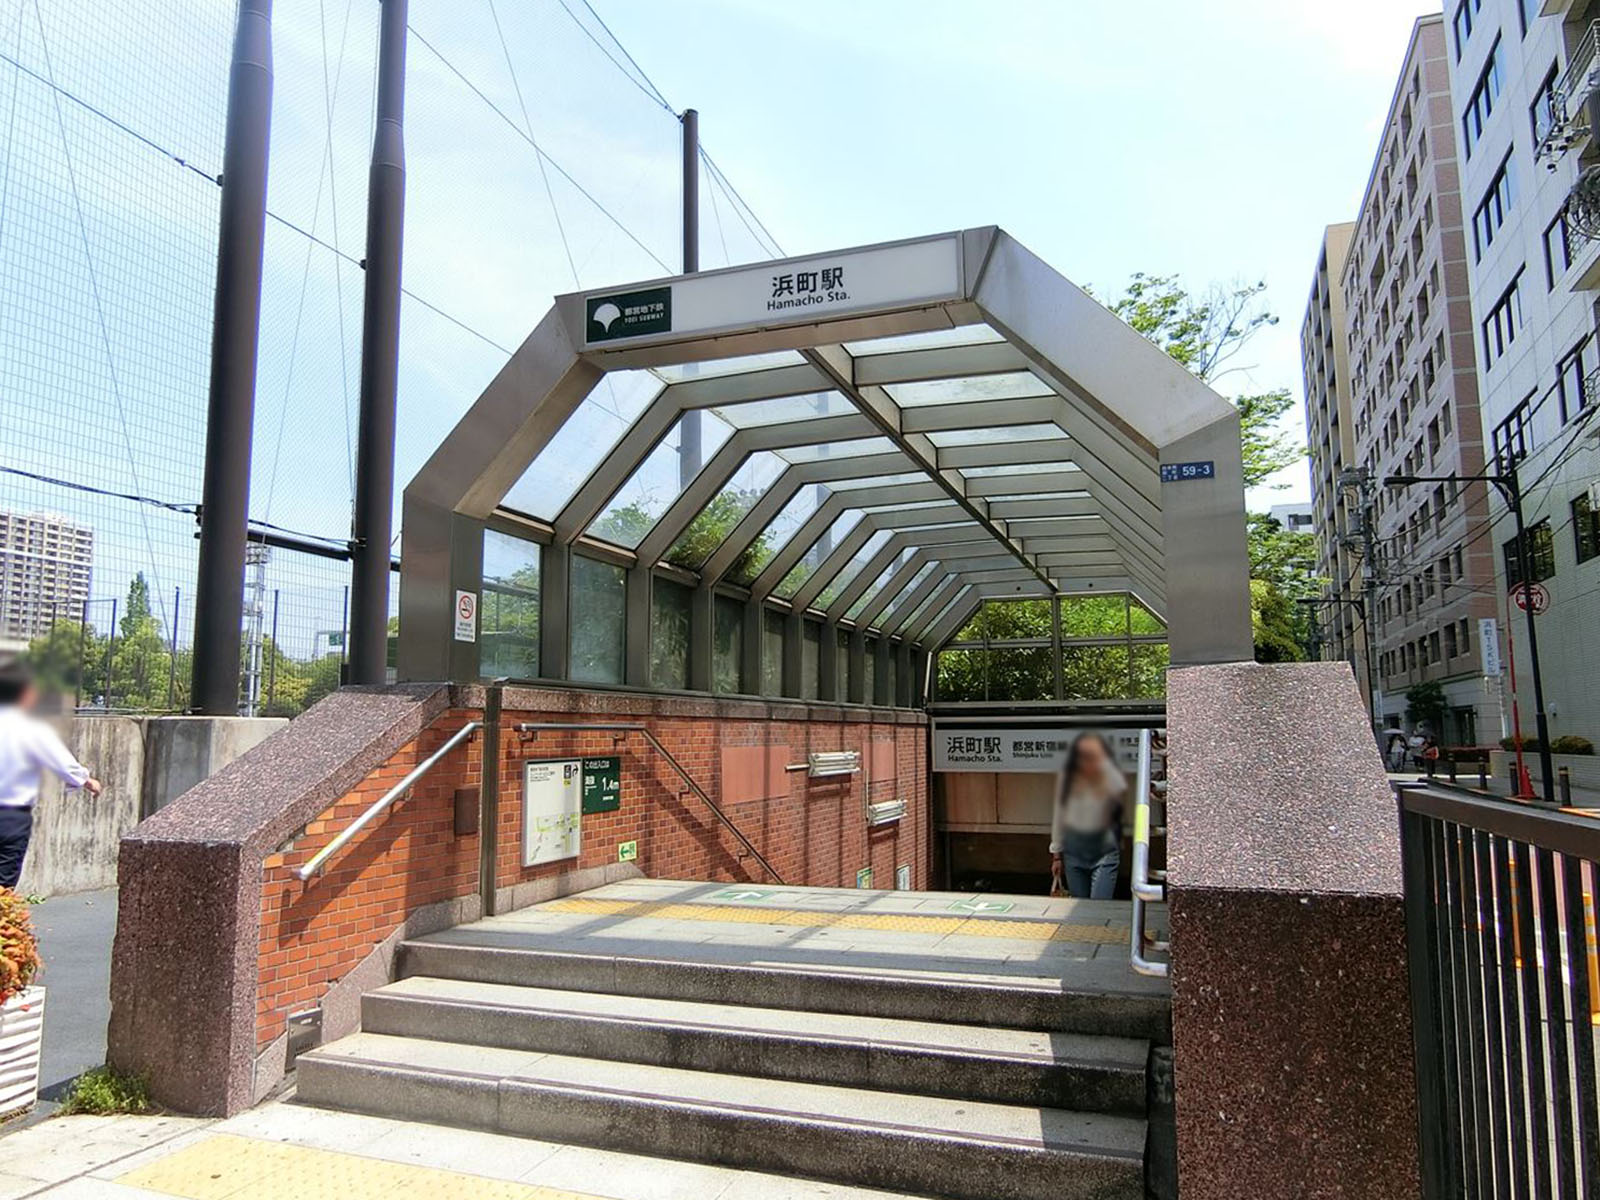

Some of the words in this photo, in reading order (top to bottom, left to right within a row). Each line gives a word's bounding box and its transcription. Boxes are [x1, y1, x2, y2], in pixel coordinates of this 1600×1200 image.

[772, 267, 844, 298] 浜町駅
[767, 294, 824, 311] Hamacho
[827, 290, 851, 302] Sta.
[1182, 464, 1211, 476] 59-3
[947, 736, 1001, 754] 浜町駅
[947, 754, 985, 762] Hamacho
